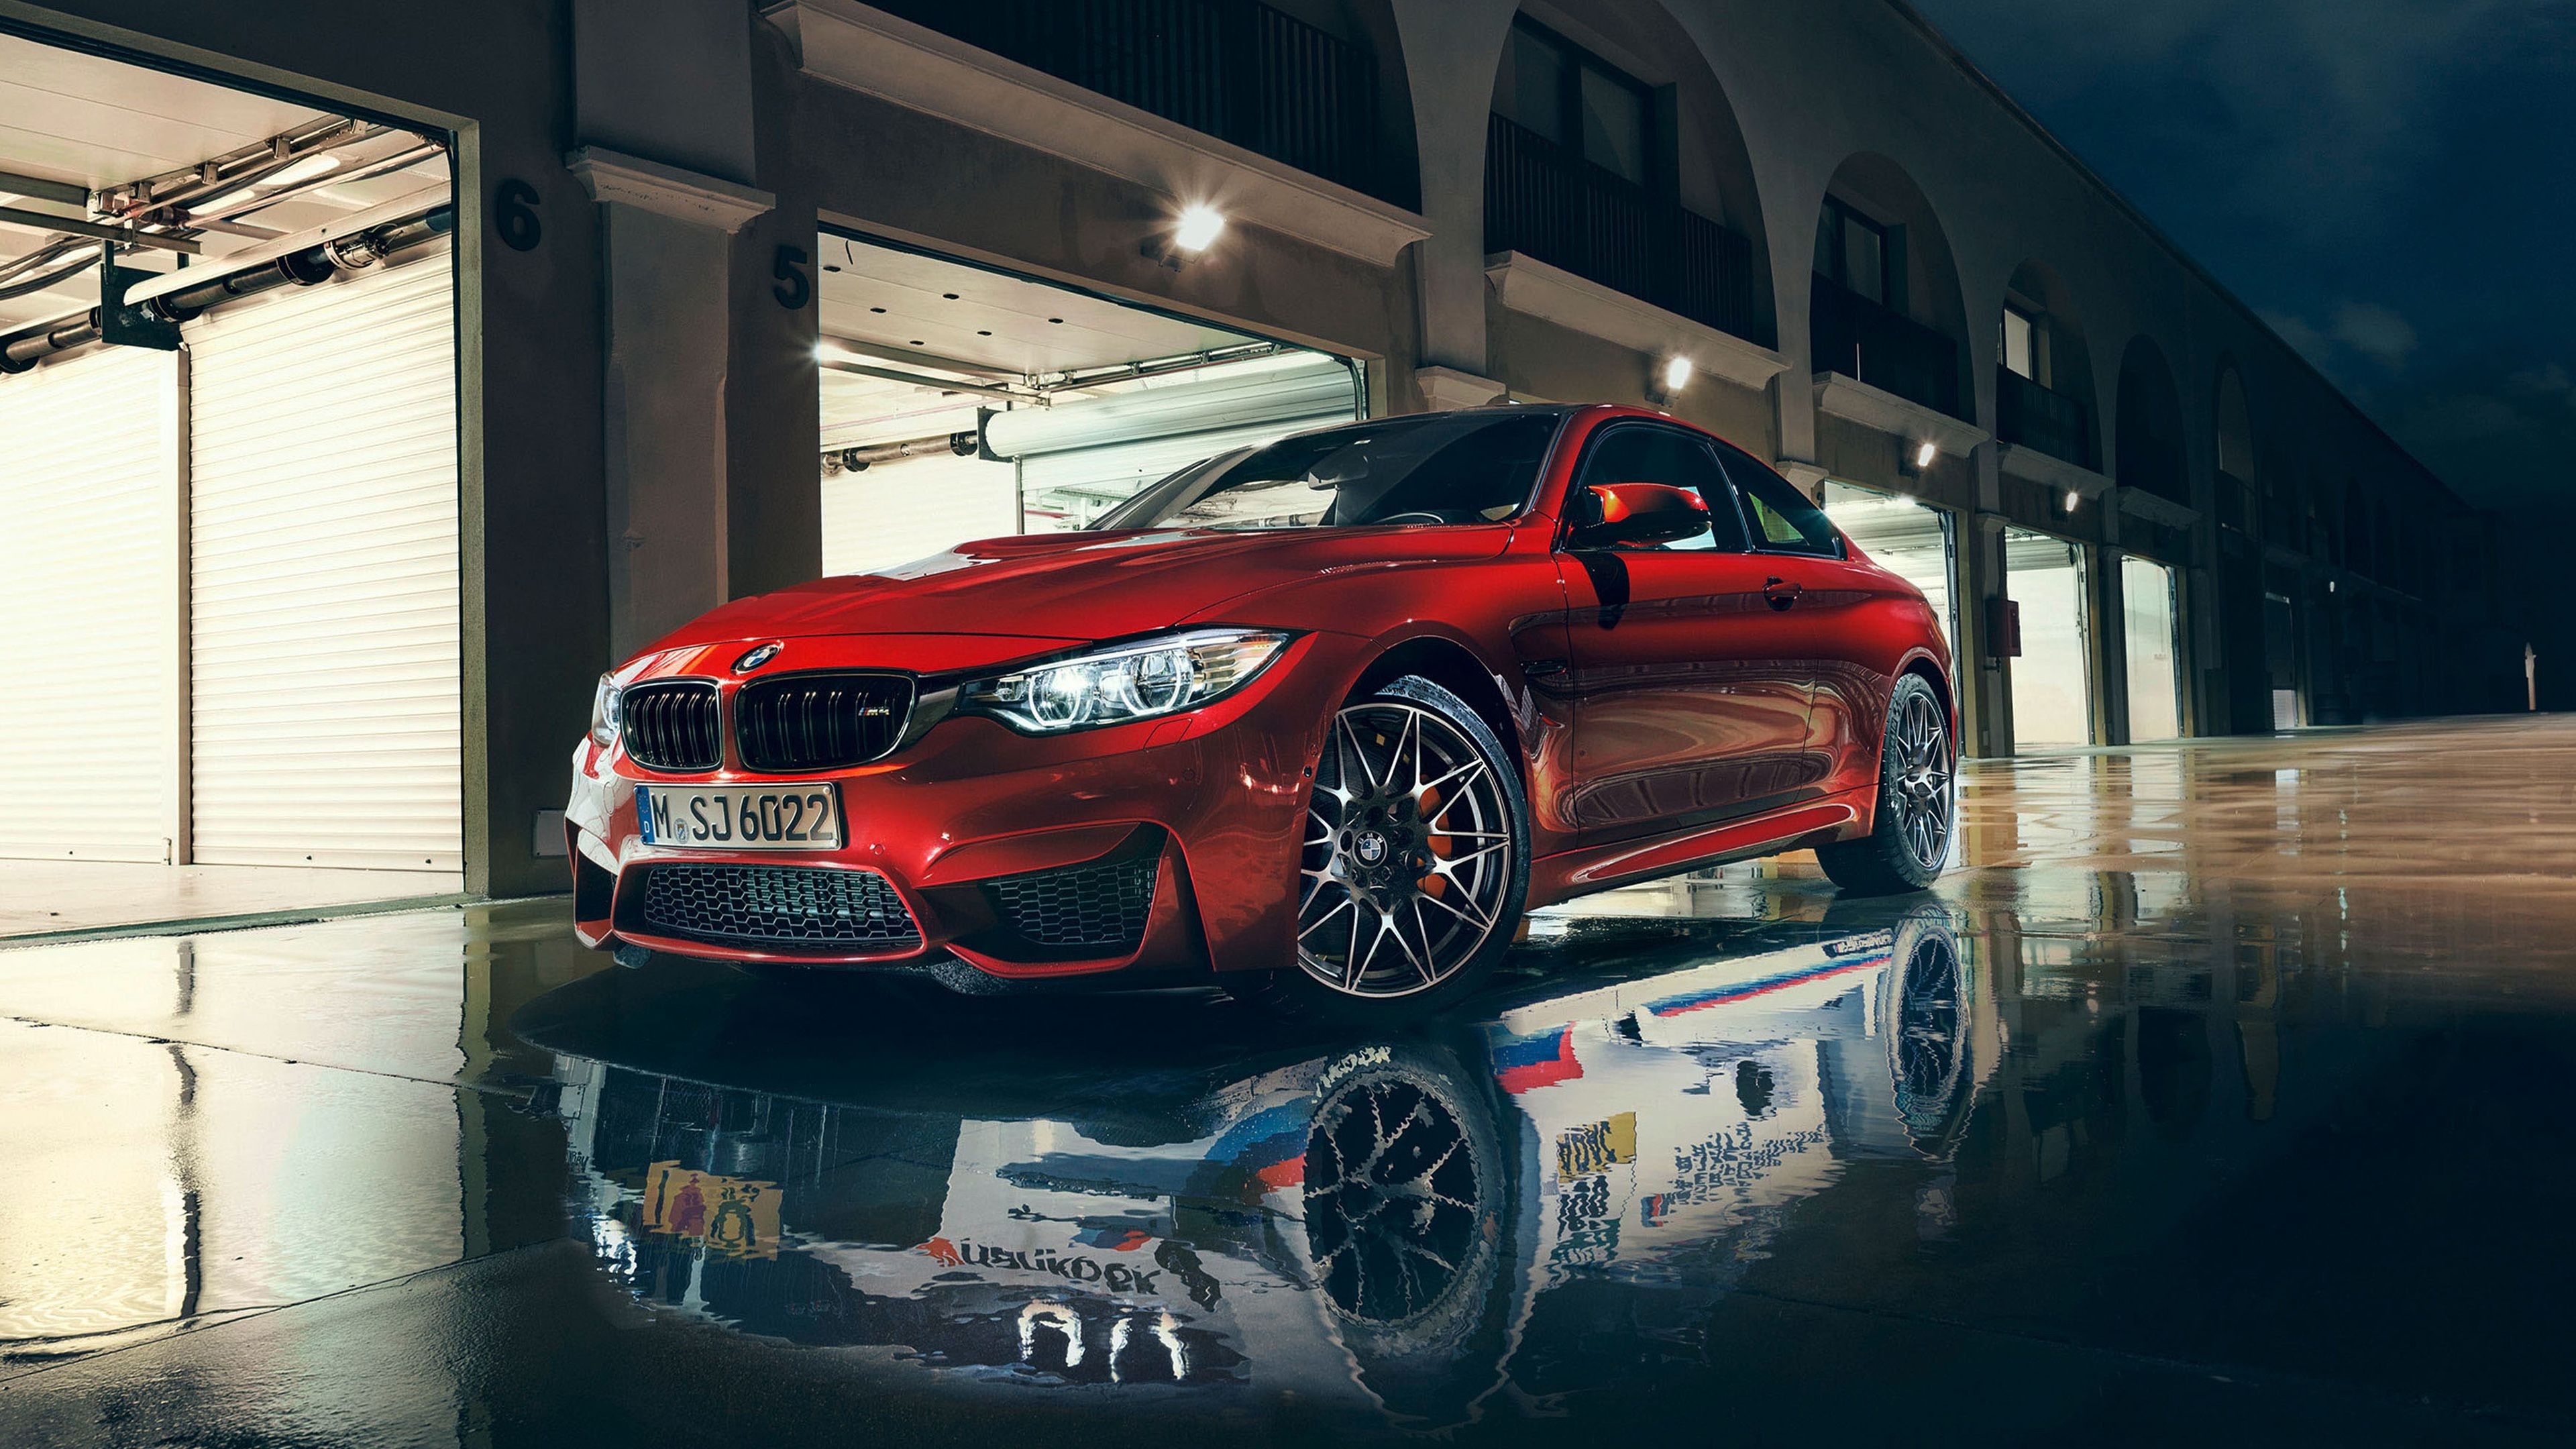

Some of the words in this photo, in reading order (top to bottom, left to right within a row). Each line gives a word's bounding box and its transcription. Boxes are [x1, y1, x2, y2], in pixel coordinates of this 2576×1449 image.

[496, 179, 541, 251] 6
[773, 244, 809, 310] 5
[644, 820, 650, 833] D
[651, 794, 672, 839] M
[690, 795, 731, 841] SJ
[739, 794, 833, 841] 6022
[1358, 833, 1384, 844] BMW
